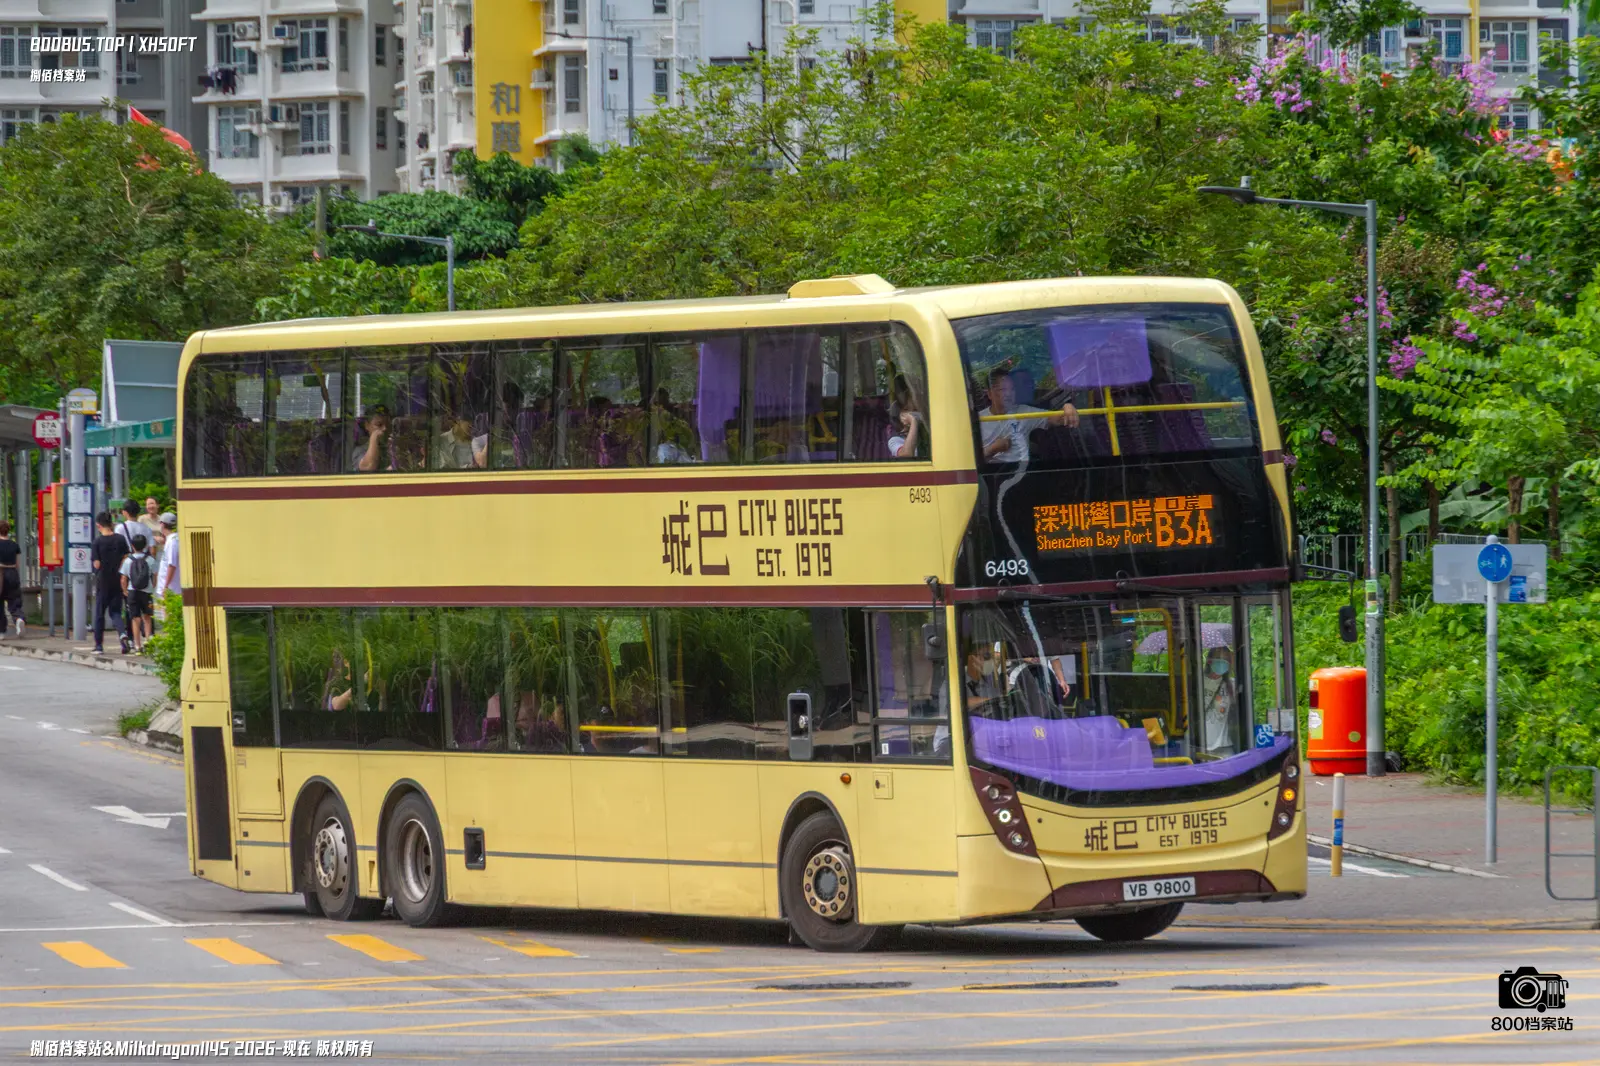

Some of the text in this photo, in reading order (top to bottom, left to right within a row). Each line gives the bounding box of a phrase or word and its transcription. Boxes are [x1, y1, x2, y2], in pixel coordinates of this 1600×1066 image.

[909, 487, 932, 504] 6493
[738, 498, 844, 537] CITY BUSES
[1033, 499, 1153, 533] 深圳灣口岸
[1155, 510, 1213, 547] B3A
[662, 500, 730, 576] 城巴
[1036, 528, 1152, 551] Shenzhen Bay Port
[756, 542, 832, 577] EST. 1979
[985, 558, 1029, 577] 6493
[1147, 811, 1227, 832] CITY BUSES
[1084, 820, 1138, 851] 城巴
[1159, 829, 1218, 847] EST 1979
[1129, 880, 1191, 897] VB 9800
